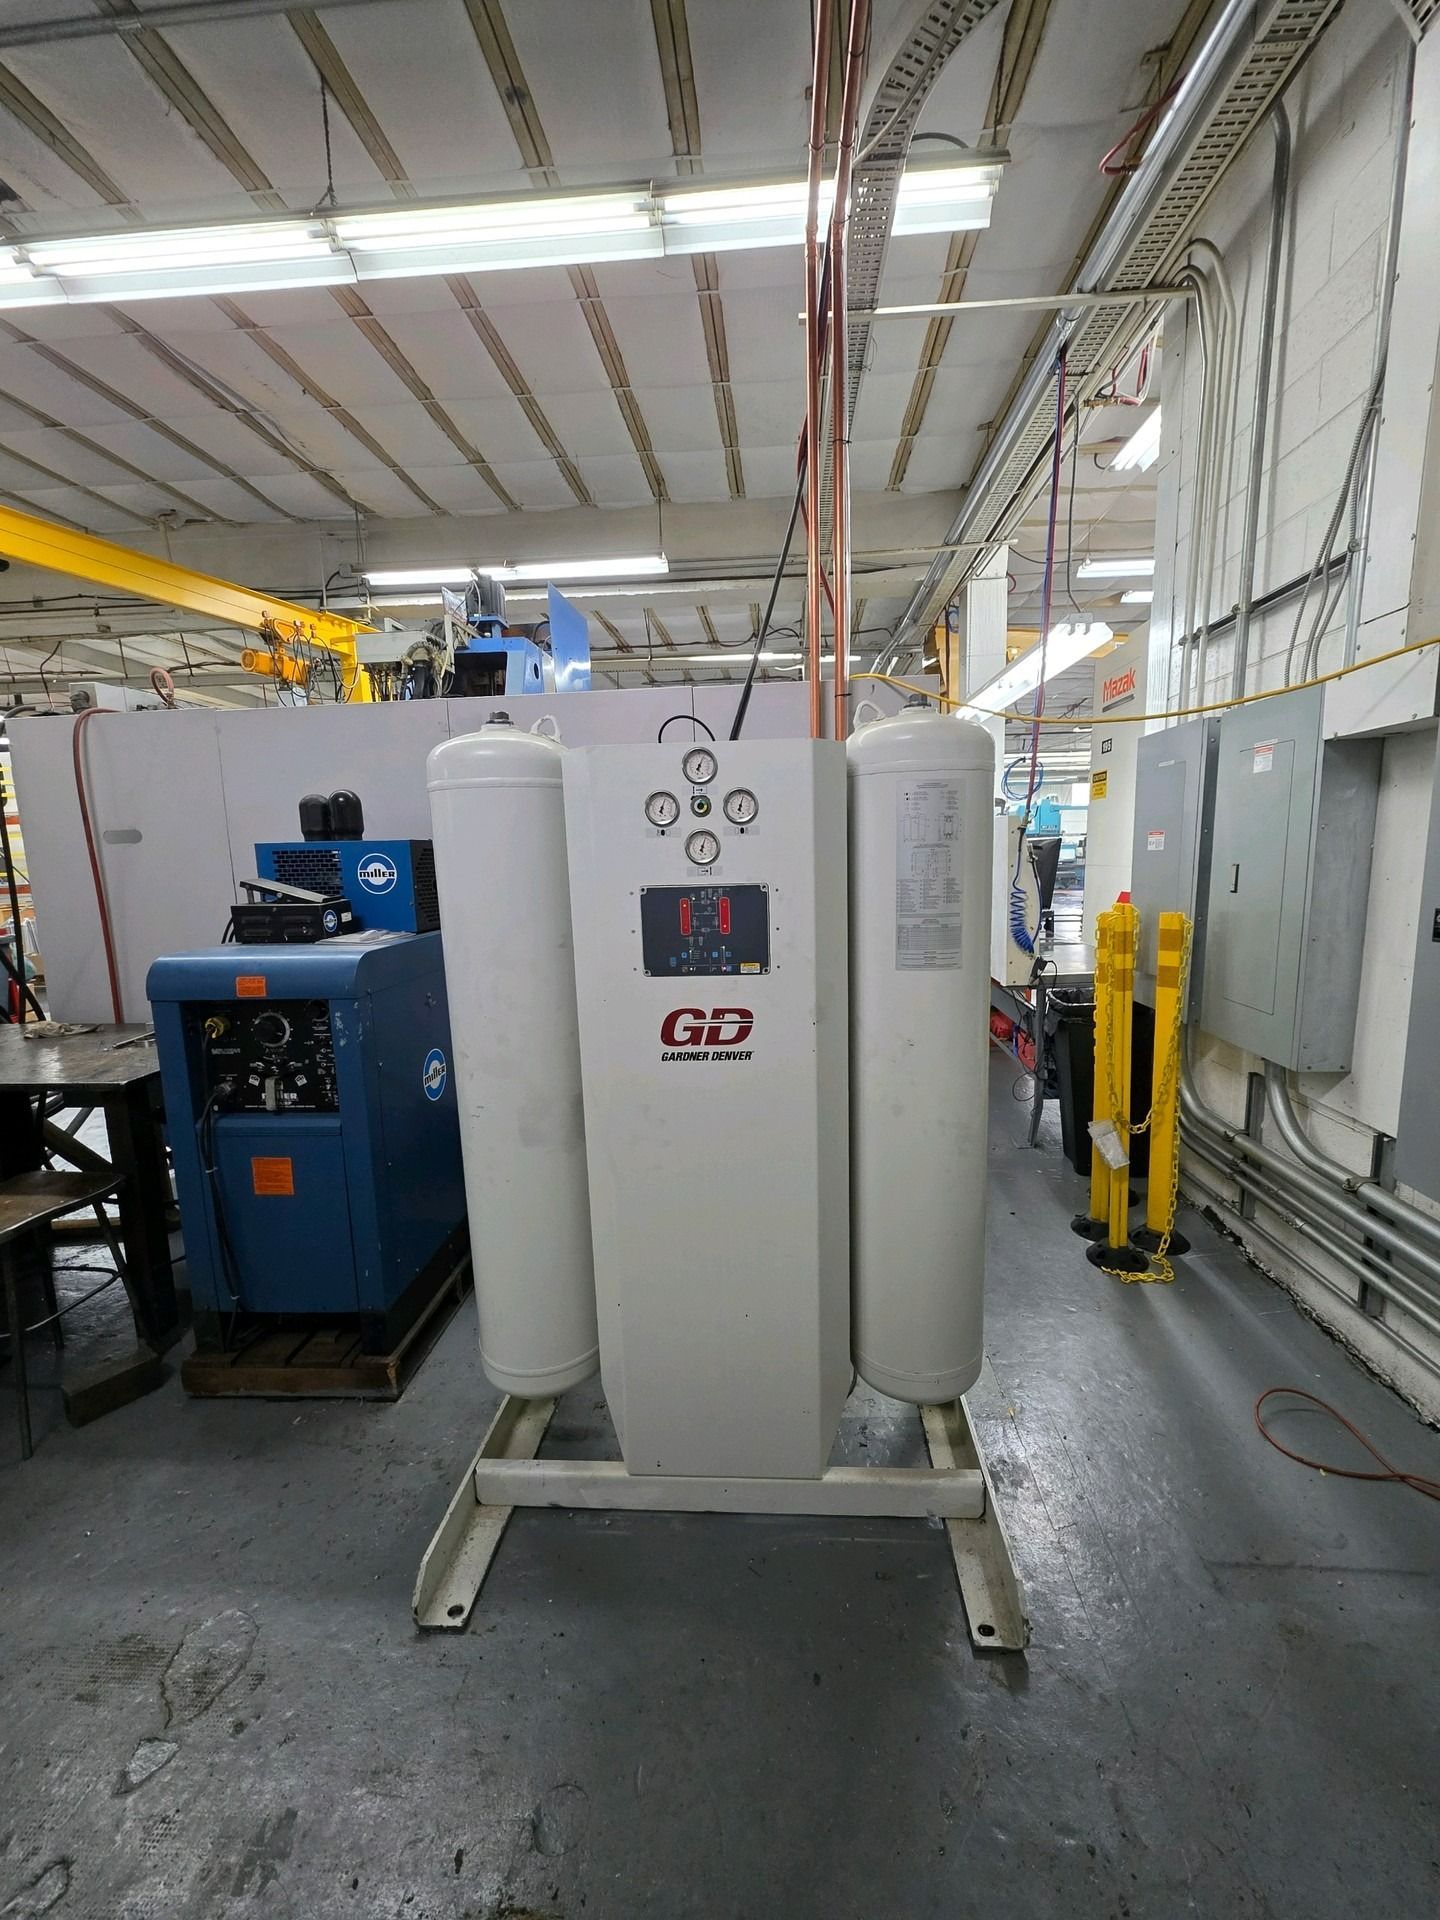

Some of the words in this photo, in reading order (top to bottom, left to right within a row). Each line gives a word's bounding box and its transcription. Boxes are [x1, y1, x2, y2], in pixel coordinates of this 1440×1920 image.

[1103, 667, 1135, 703] Mazak
[661, 1008, 753, 1047] GD
[661, 1051, 710, 1062] GARDNER
[711, 1050, 753, 1061] DENVER
